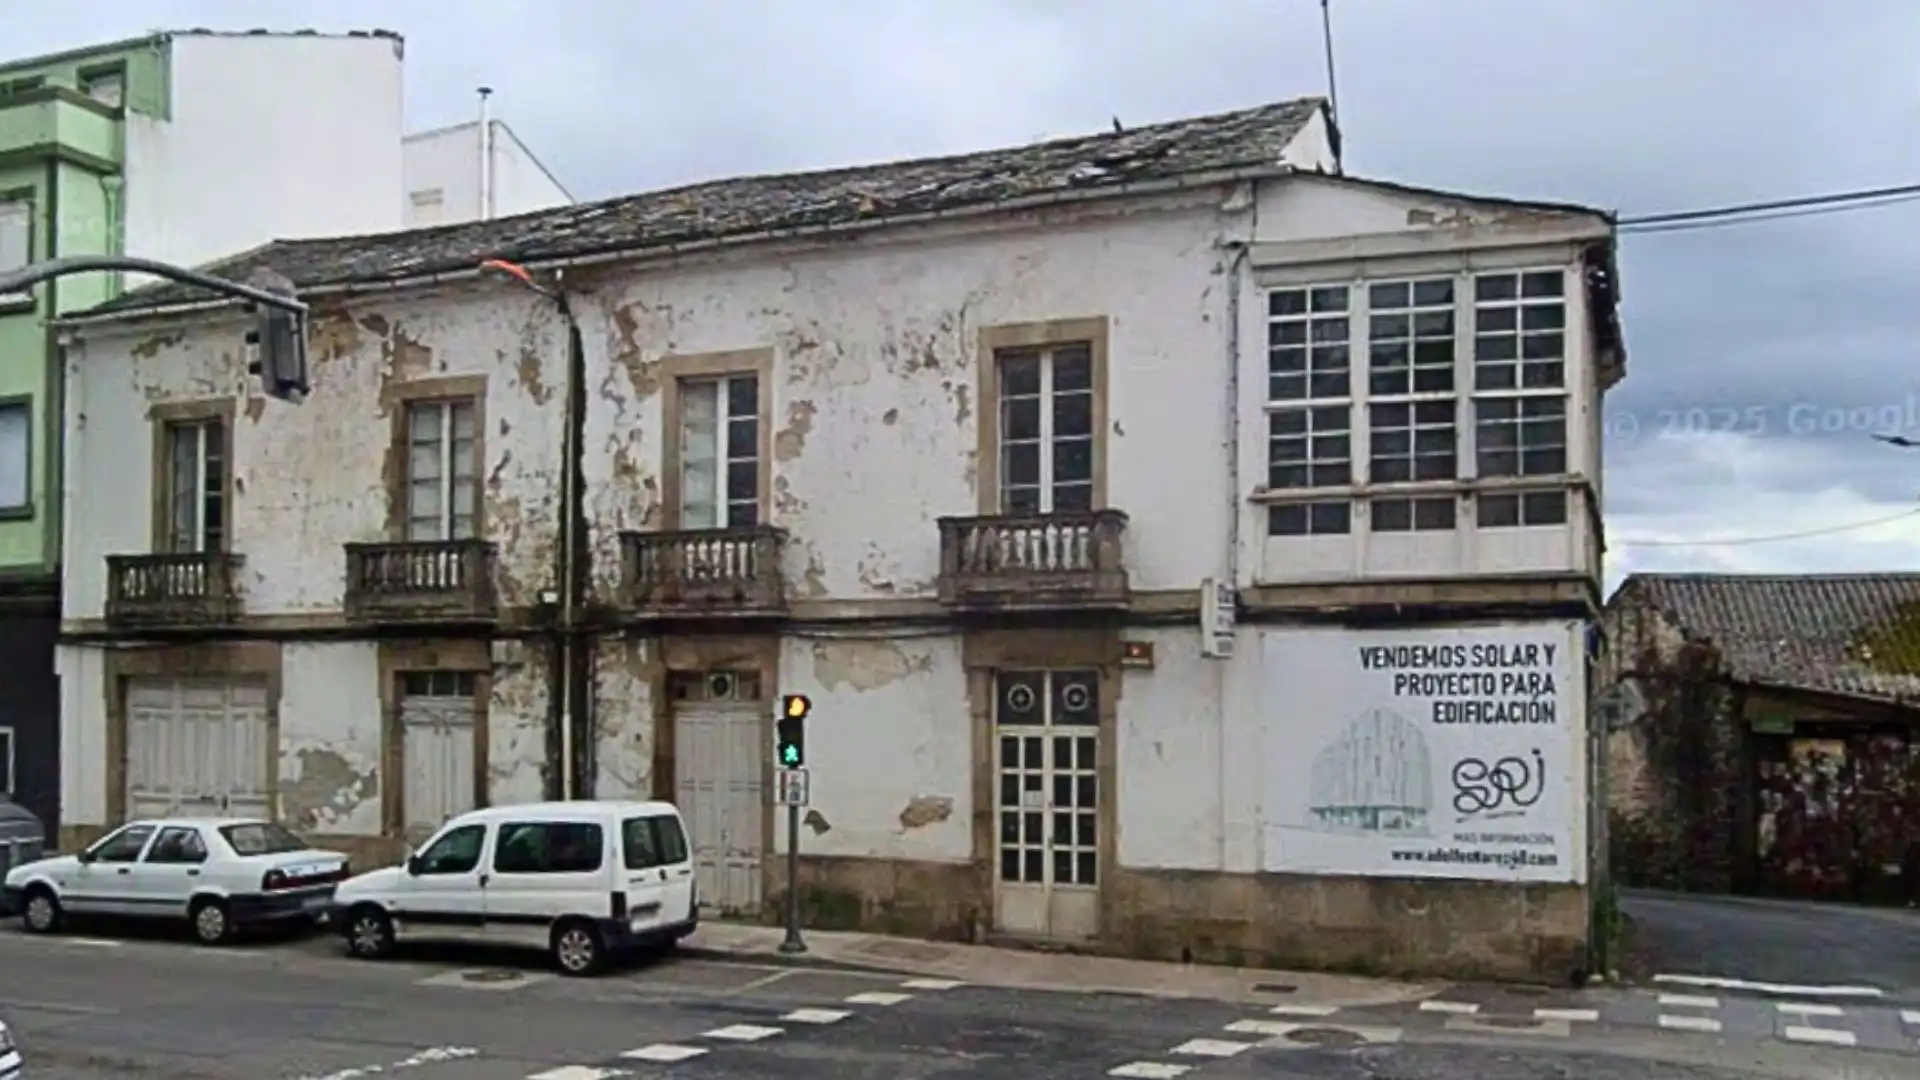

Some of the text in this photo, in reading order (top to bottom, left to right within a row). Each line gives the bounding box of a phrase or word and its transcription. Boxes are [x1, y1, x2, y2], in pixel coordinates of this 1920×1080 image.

[1360, 644, 1556, 669] VENDEMOS SOLAR Y
[1394, 672, 1556, 696] PROYECTO PARA
[1432, 695, 1556, 724] EDIFICACIÓN
